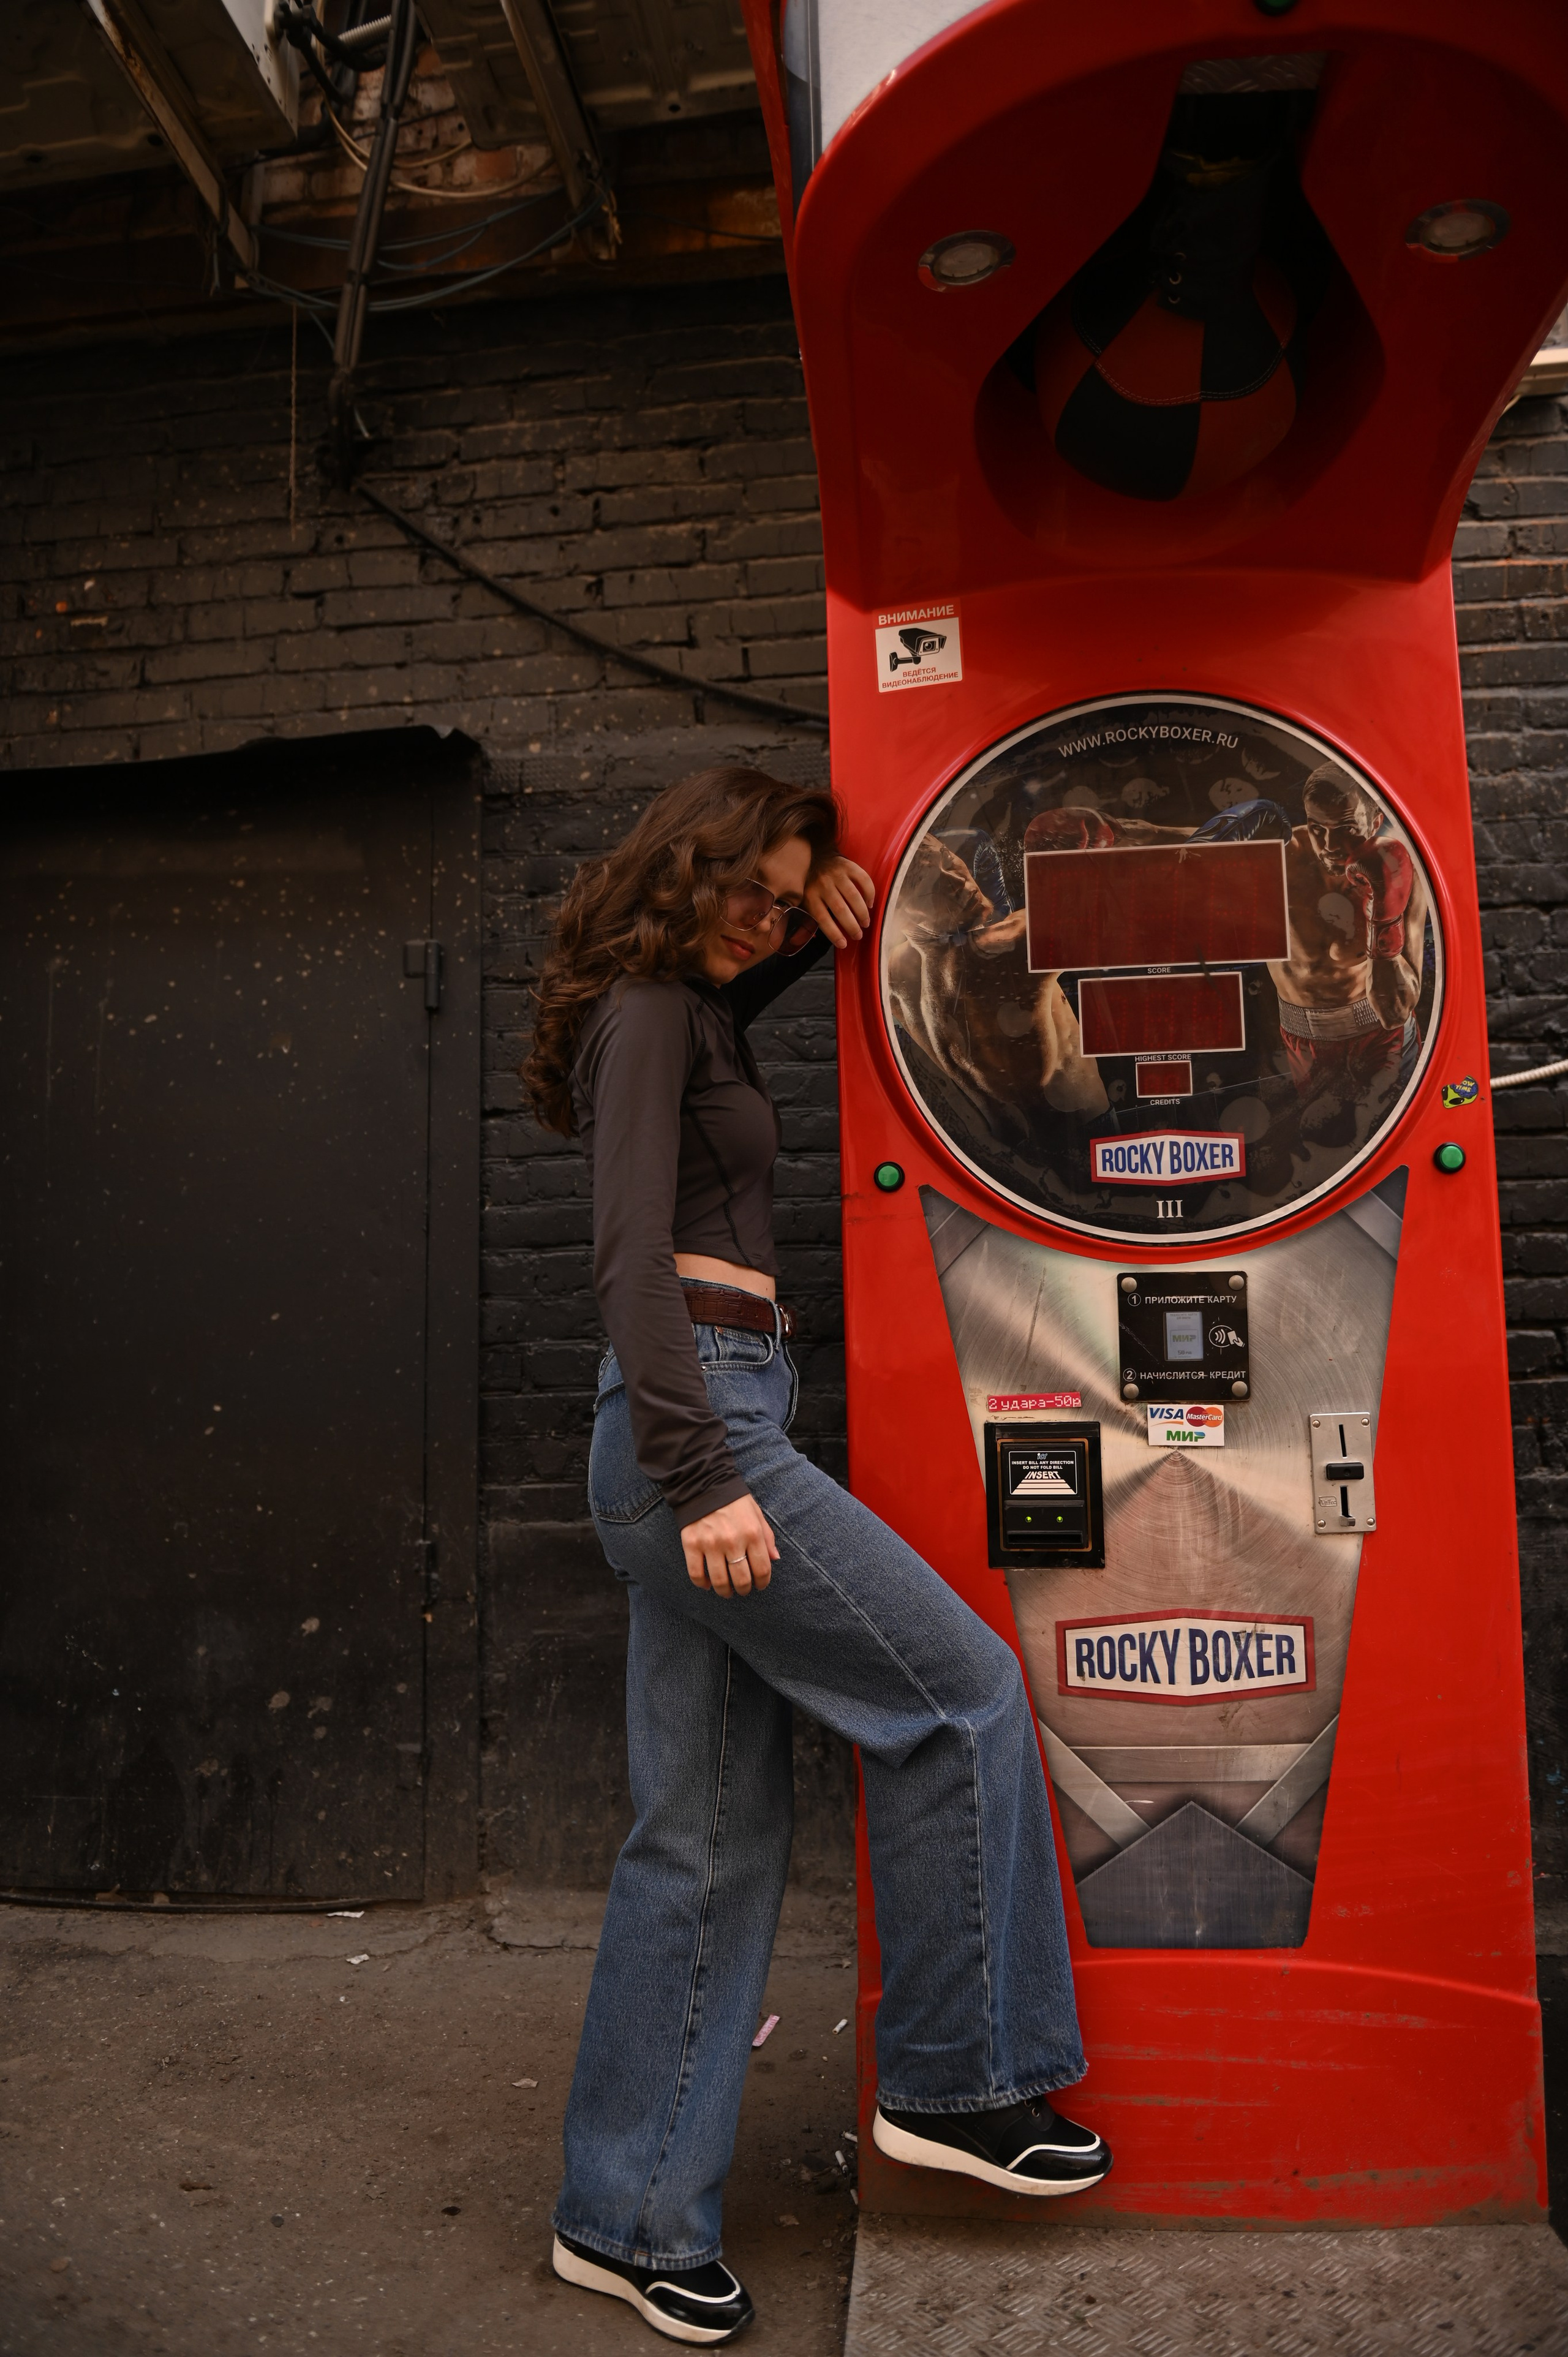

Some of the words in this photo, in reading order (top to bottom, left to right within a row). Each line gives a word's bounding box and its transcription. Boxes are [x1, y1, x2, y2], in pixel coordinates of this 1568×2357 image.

[878, 605, 954, 625] ВНИМАНИЕ
[902, 666, 936, 677] ВЕДЁТСЯ
[882, 671, 959, 688] ВИДЕОНАБЛЮДЕНИЕ
[1058, 726, 1238, 758] WWW.ROCKYBOXER.RU
[1101, 1141, 1165, 1174] ROCKY
[1169, 1141, 1234, 1174] BOXER
[1145, 1295, 1205, 1304] ПРИЛОЖИТЕ
[1209, 1371, 1246, 1379] КРЕДИТ
[989, 1398, 997, 1409] 2
[1149, 1408, 1183, 1419] VISA
[1166, 1430, 1205, 1442] МИР
[1075, 1628, 1180, 1685] ROCKY
[1188, 1628, 1296, 1686] BOXER
